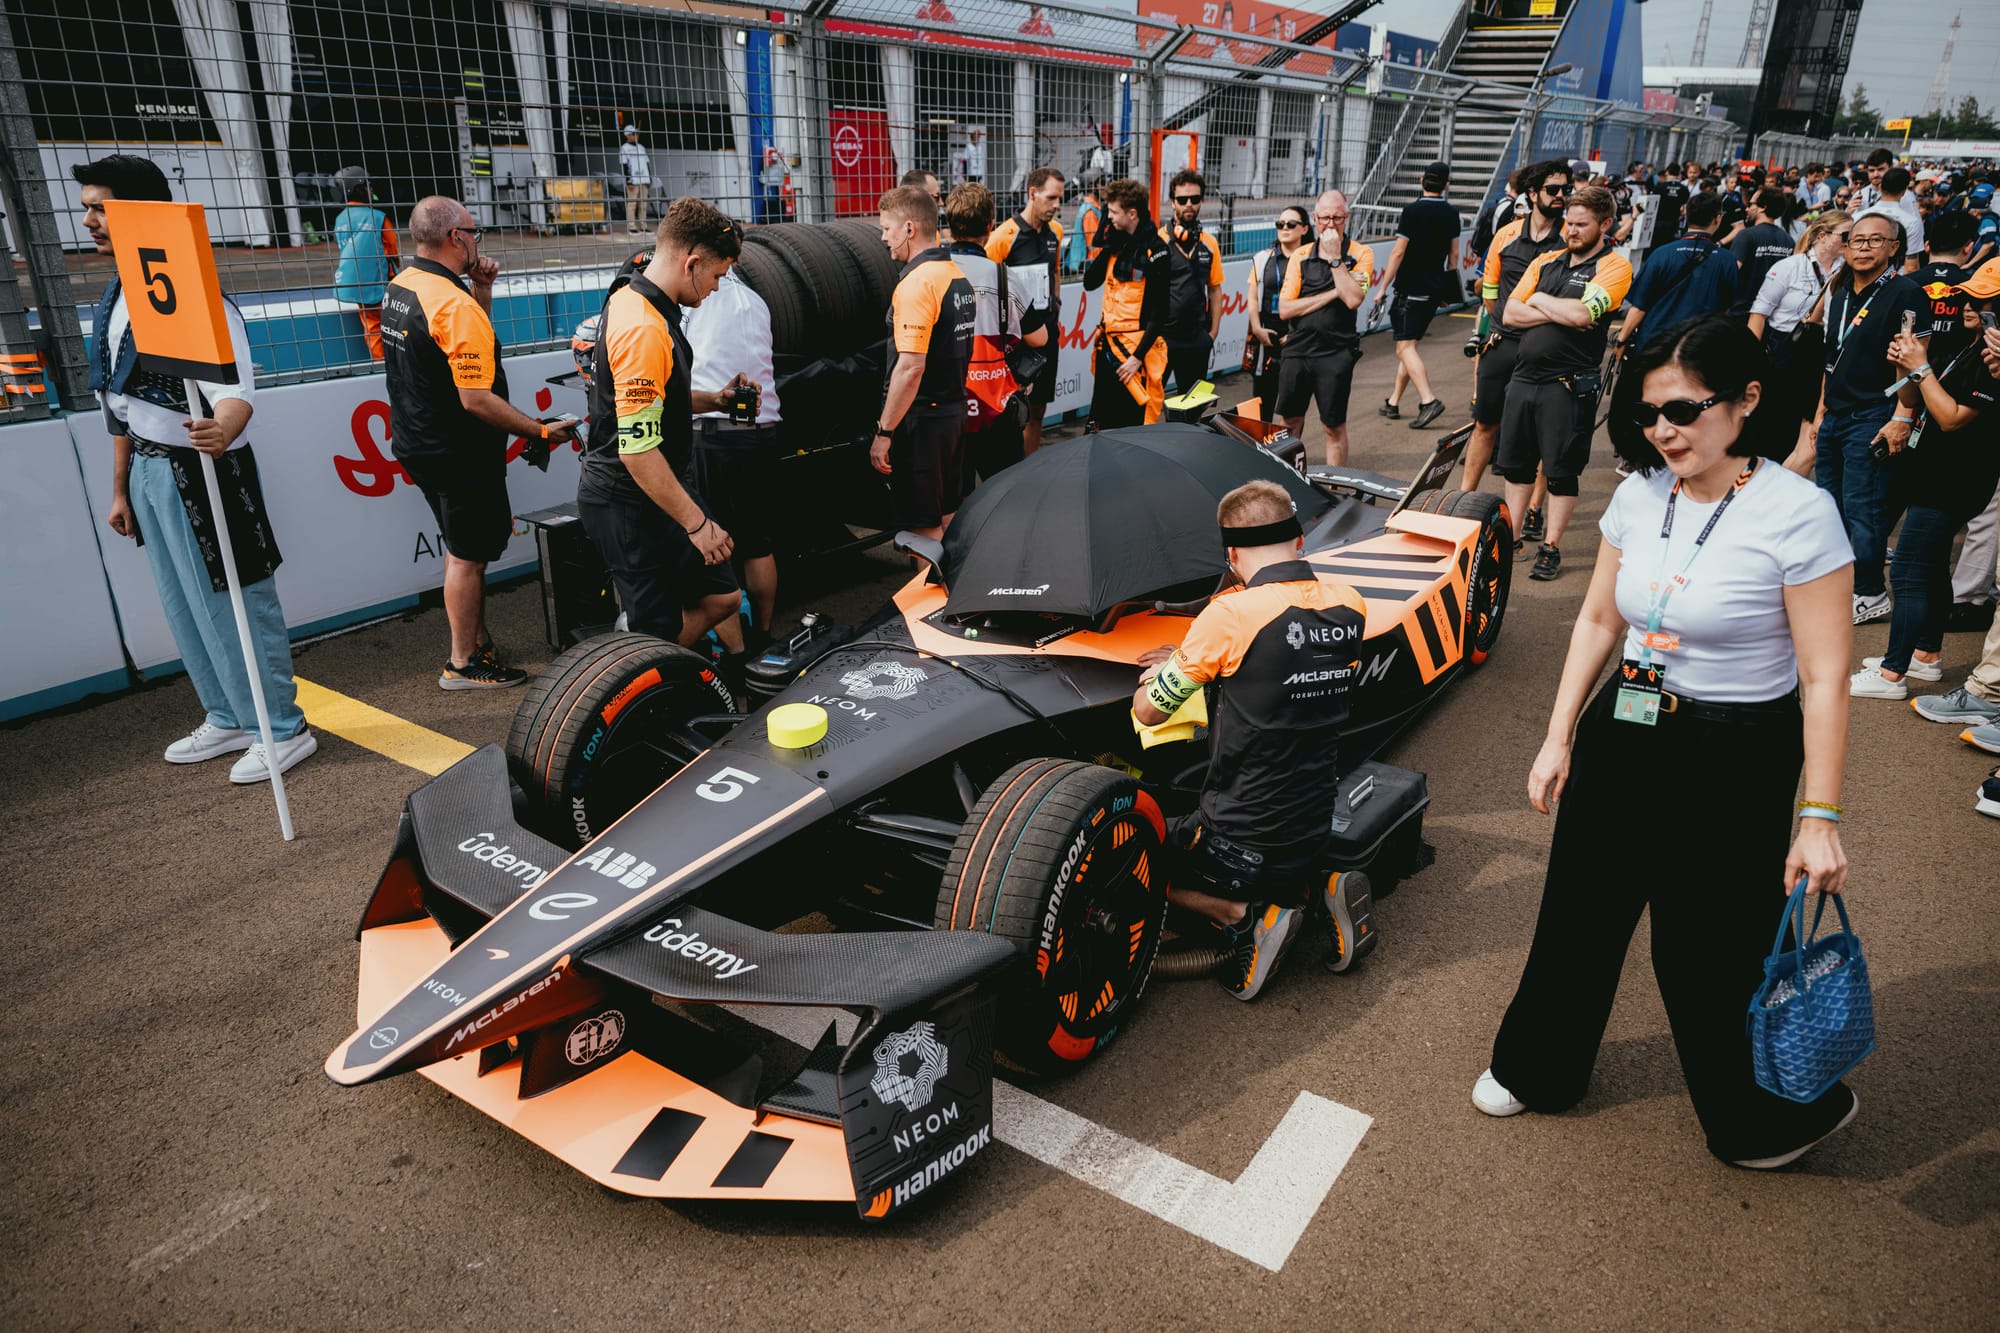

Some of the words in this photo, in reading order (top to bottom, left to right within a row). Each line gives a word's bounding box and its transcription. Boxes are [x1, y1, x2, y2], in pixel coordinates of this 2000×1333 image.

[1202, 2, 1219, 24] 27
[135, 104, 198, 115] PENSKE
[833, 141, 863, 151] NISSAN
[137, 247, 178, 316] 5
[390, 298, 411, 315] NEOM
[464, 352, 480, 360] TDK
[635, 378, 655, 387] TDK
[1055, 372, 1081, 397] etail
[987, 587, 1042, 596] McLaren
[1309, 624, 1358, 643] NEOM
[1282, 668, 1351, 685] McLaren
[1291, 689, 1324, 699] FORMULA
[805, 693, 878, 722] NEOM
[695, 766, 762, 802] 5
[573, 846, 658, 890] ABB
[422, 977, 468, 1007] NEOM
[444, 970, 561, 1051] McLaren
[373, 1030, 395, 1046] NISSAN
[892, 1101, 960, 1154] NEOM
